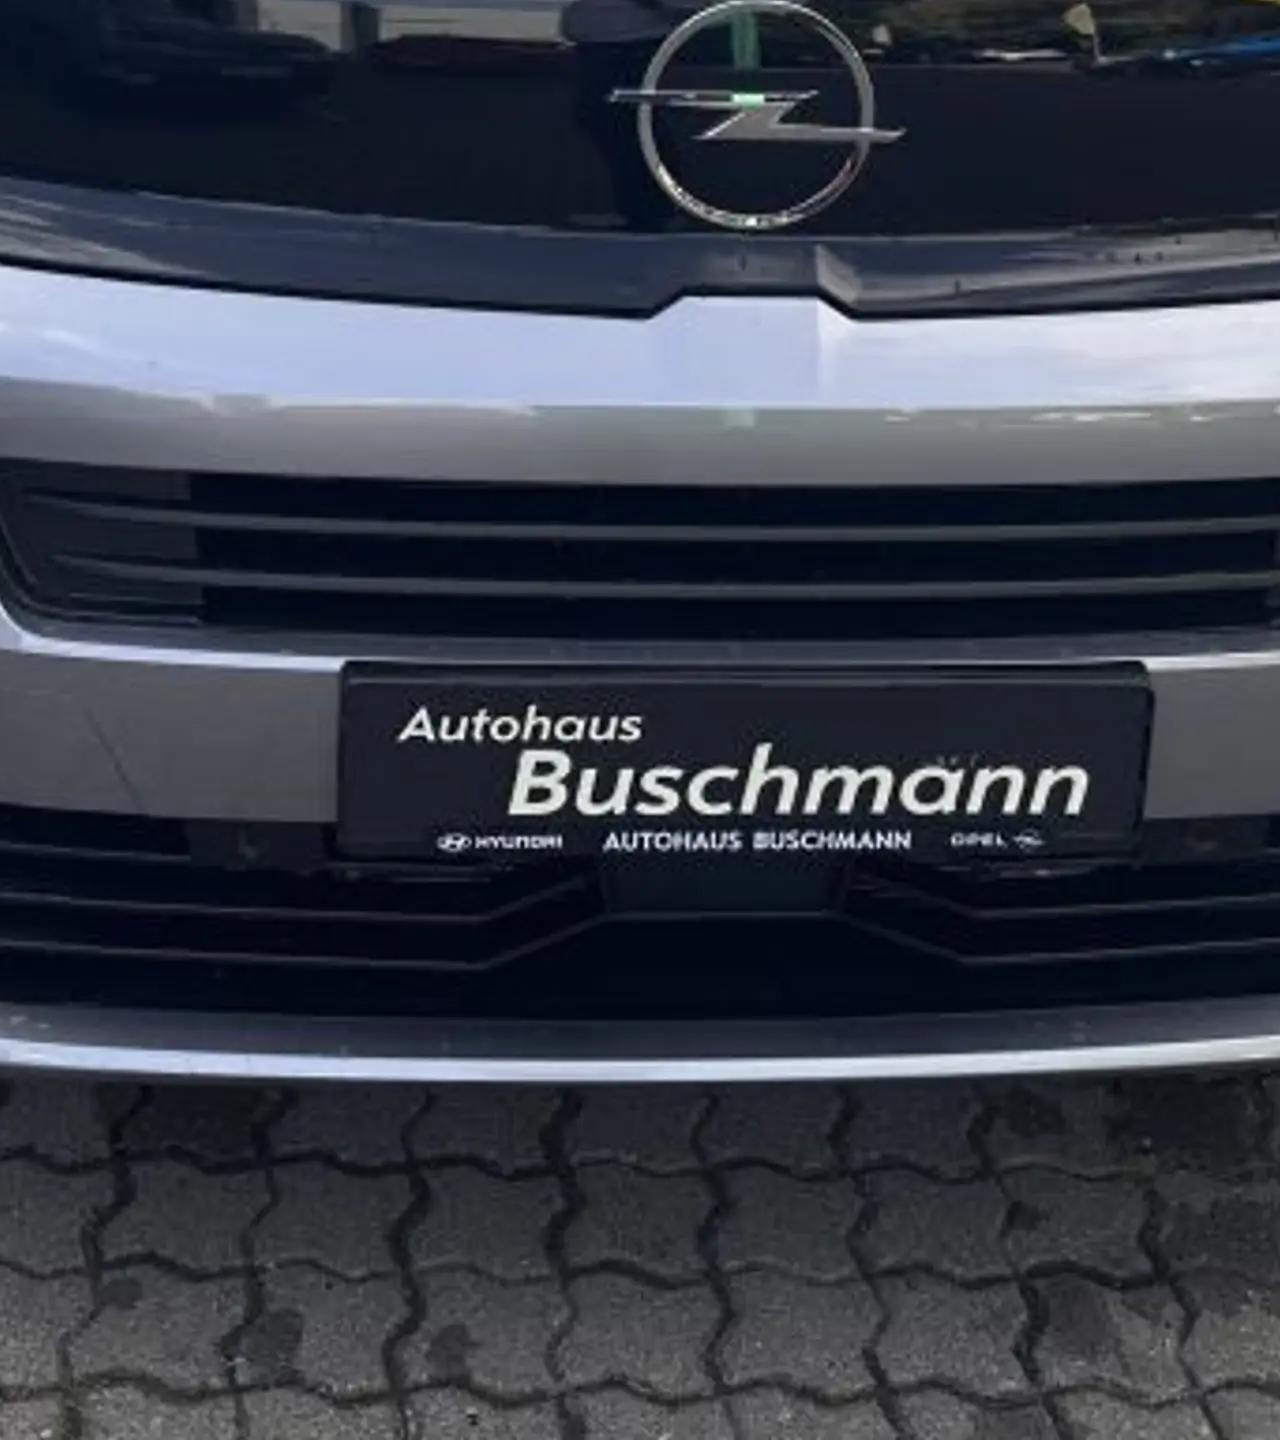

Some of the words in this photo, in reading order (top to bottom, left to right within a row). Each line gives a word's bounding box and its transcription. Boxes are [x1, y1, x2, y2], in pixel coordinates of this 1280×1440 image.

[397, 704, 644, 742] Autohaus
[506, 741, 1090, 817] Buschmann
[475, 834, 564, 850] HYUNDAI
[602, 831, 744, 852] AUTOHAUS
[752, 828, 913, 851] BUSCHMANN
[950, 831, 1006, 848] OPEL
